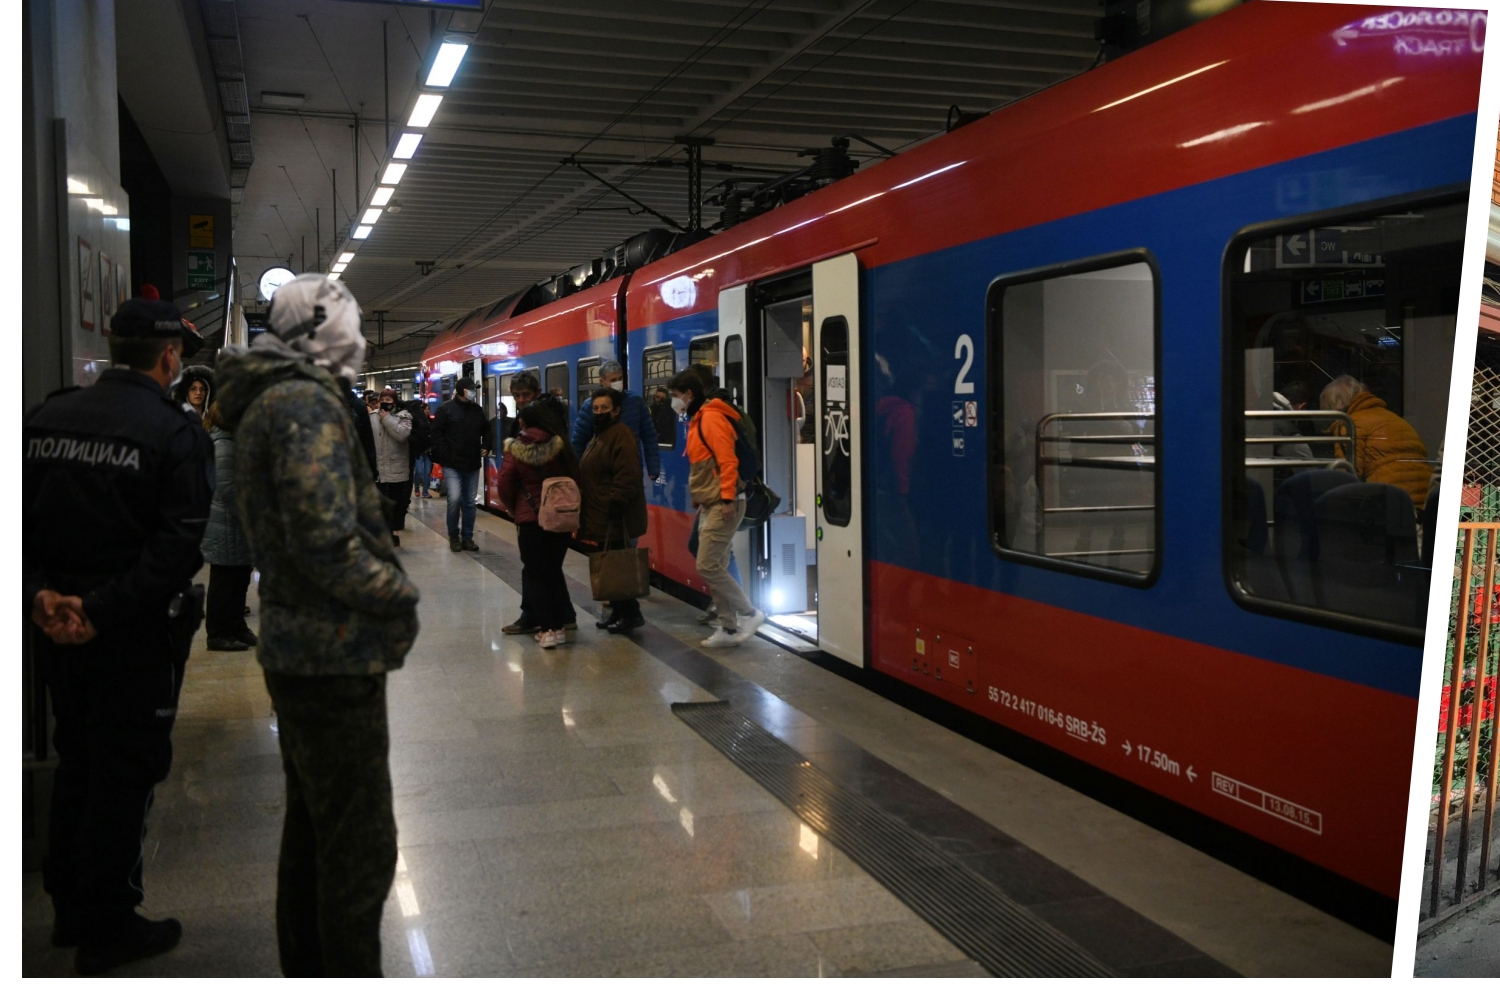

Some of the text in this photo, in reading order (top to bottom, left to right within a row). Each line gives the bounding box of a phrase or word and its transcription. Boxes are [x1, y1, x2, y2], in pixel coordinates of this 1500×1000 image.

[954, 333, 975, 395] 2
[27, 437, 140, 471] ПОЛИЦИЈА
[953, 437, 964, 450] WC
[988, 685, 1107, 745] 55 72 2 417 016-6 SRB-ŽS
[1137, 744, 1180, 776] 17.50m
[1216, 777, 1235, 794] REV
